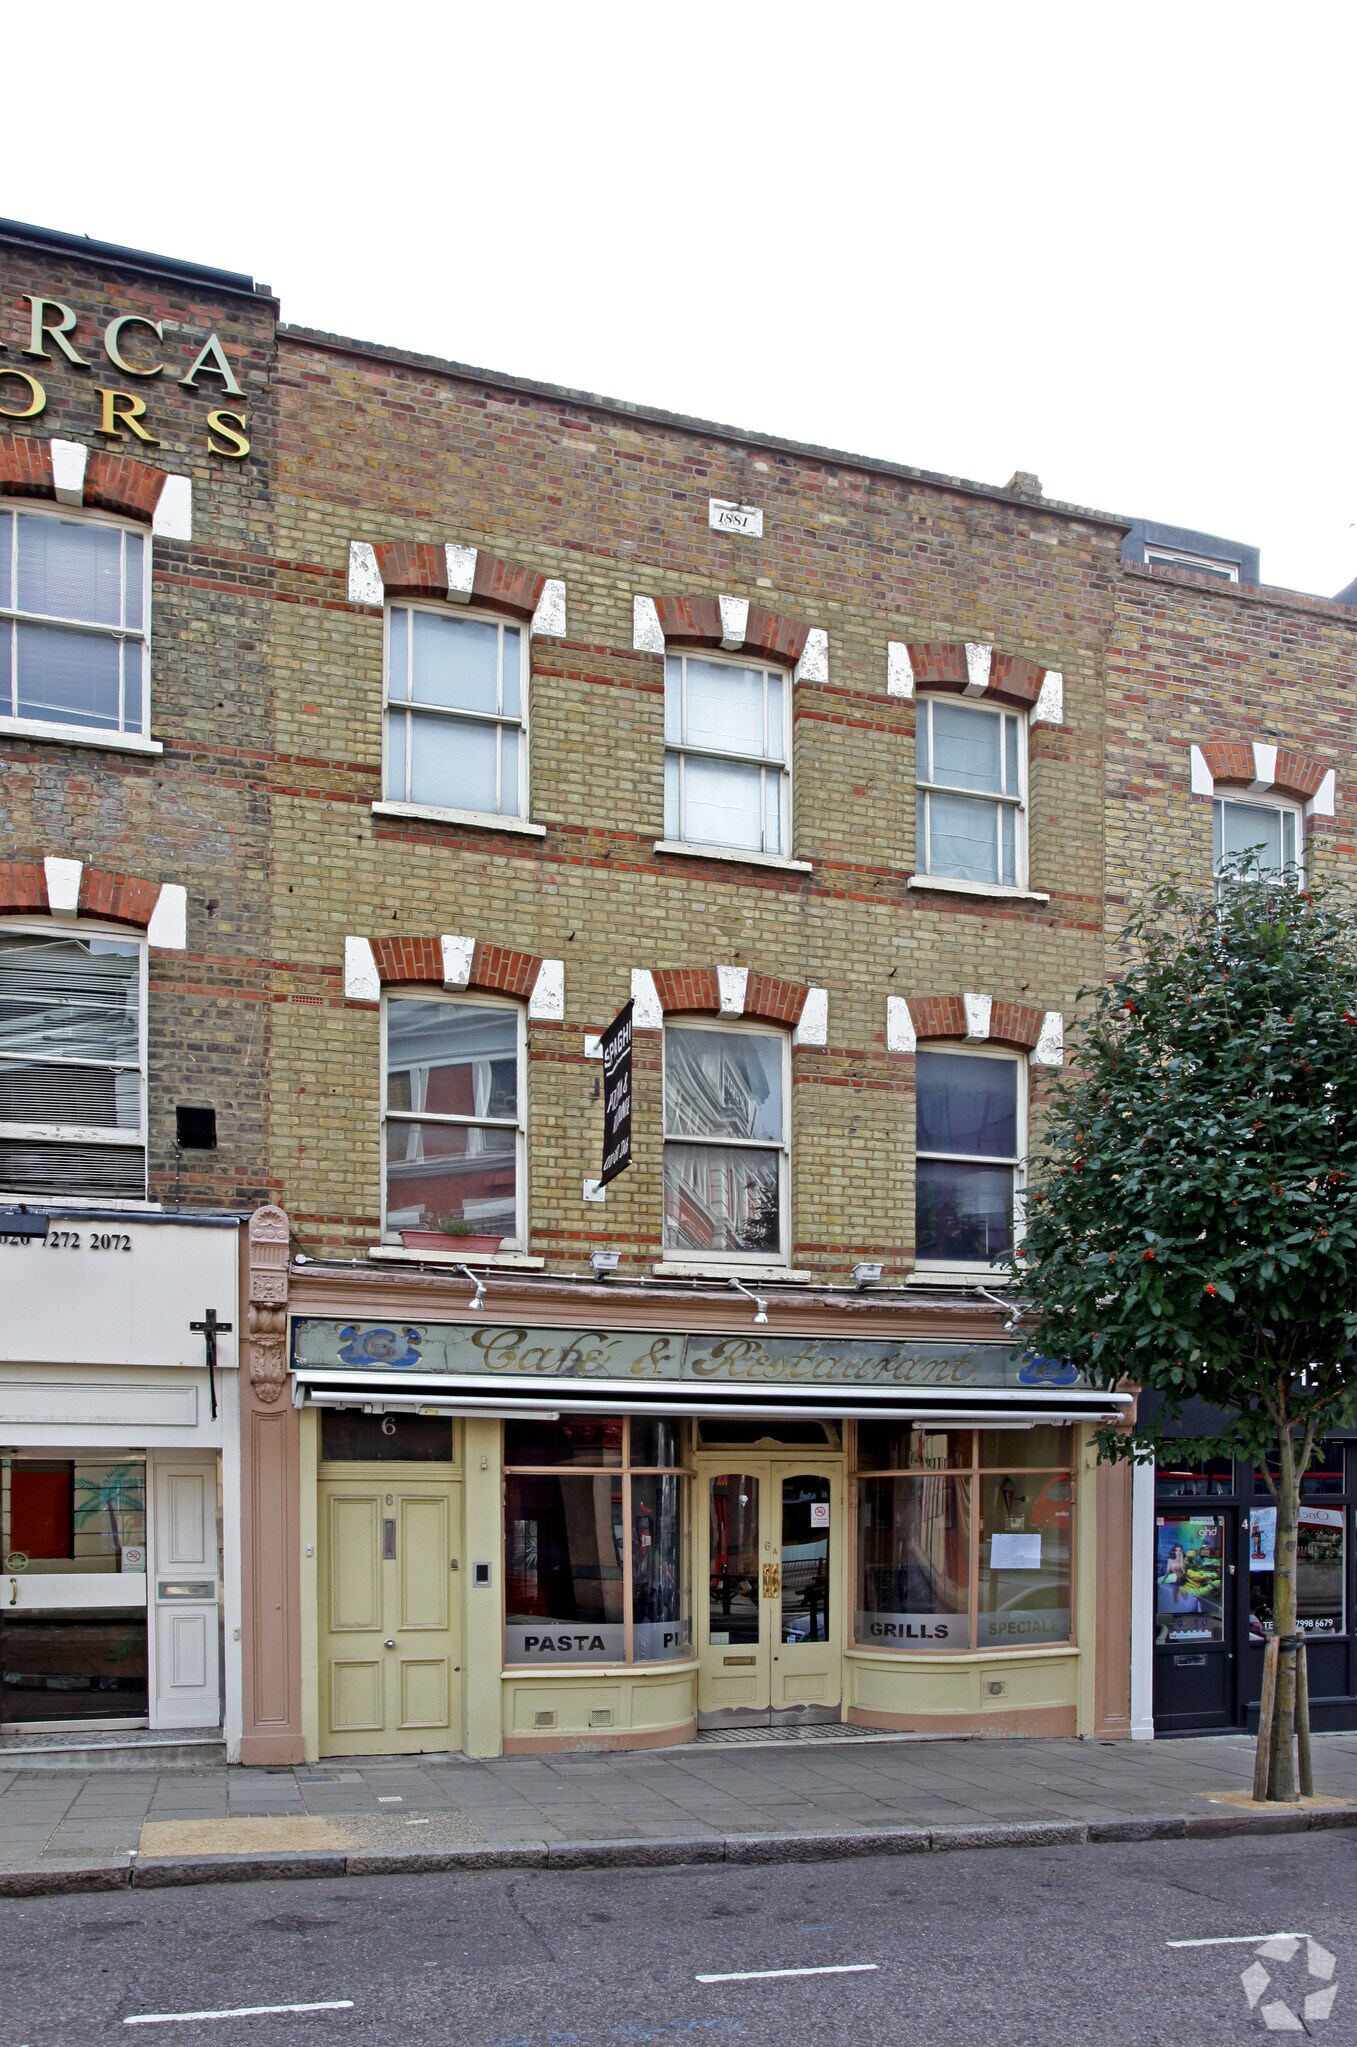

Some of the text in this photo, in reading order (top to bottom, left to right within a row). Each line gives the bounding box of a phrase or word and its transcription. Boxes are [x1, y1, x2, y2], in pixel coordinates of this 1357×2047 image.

[0, 292, 248, 400] RCA
[718, 512, 748, 527] 1881
[604, 1020, 632, 1069] SPAGHI
[89, 1233, 132, 1251] 2072
[364, 1333, 397, 1360] 6
[471, 1328, 980, 1383] Café & Restaurant
[381, 1417, 396, 1435] 6
[385, 1493, 394, 1506] 6
[1198, 1526, 1218, 1539] ghd
[1241, 1519, 1249, 1530] 4
[870, 1622, 949, 1639] GRILLS
[1314, 1618, 1334, 1628] 6679
[524, 1635, 606, 1652] PASTA
